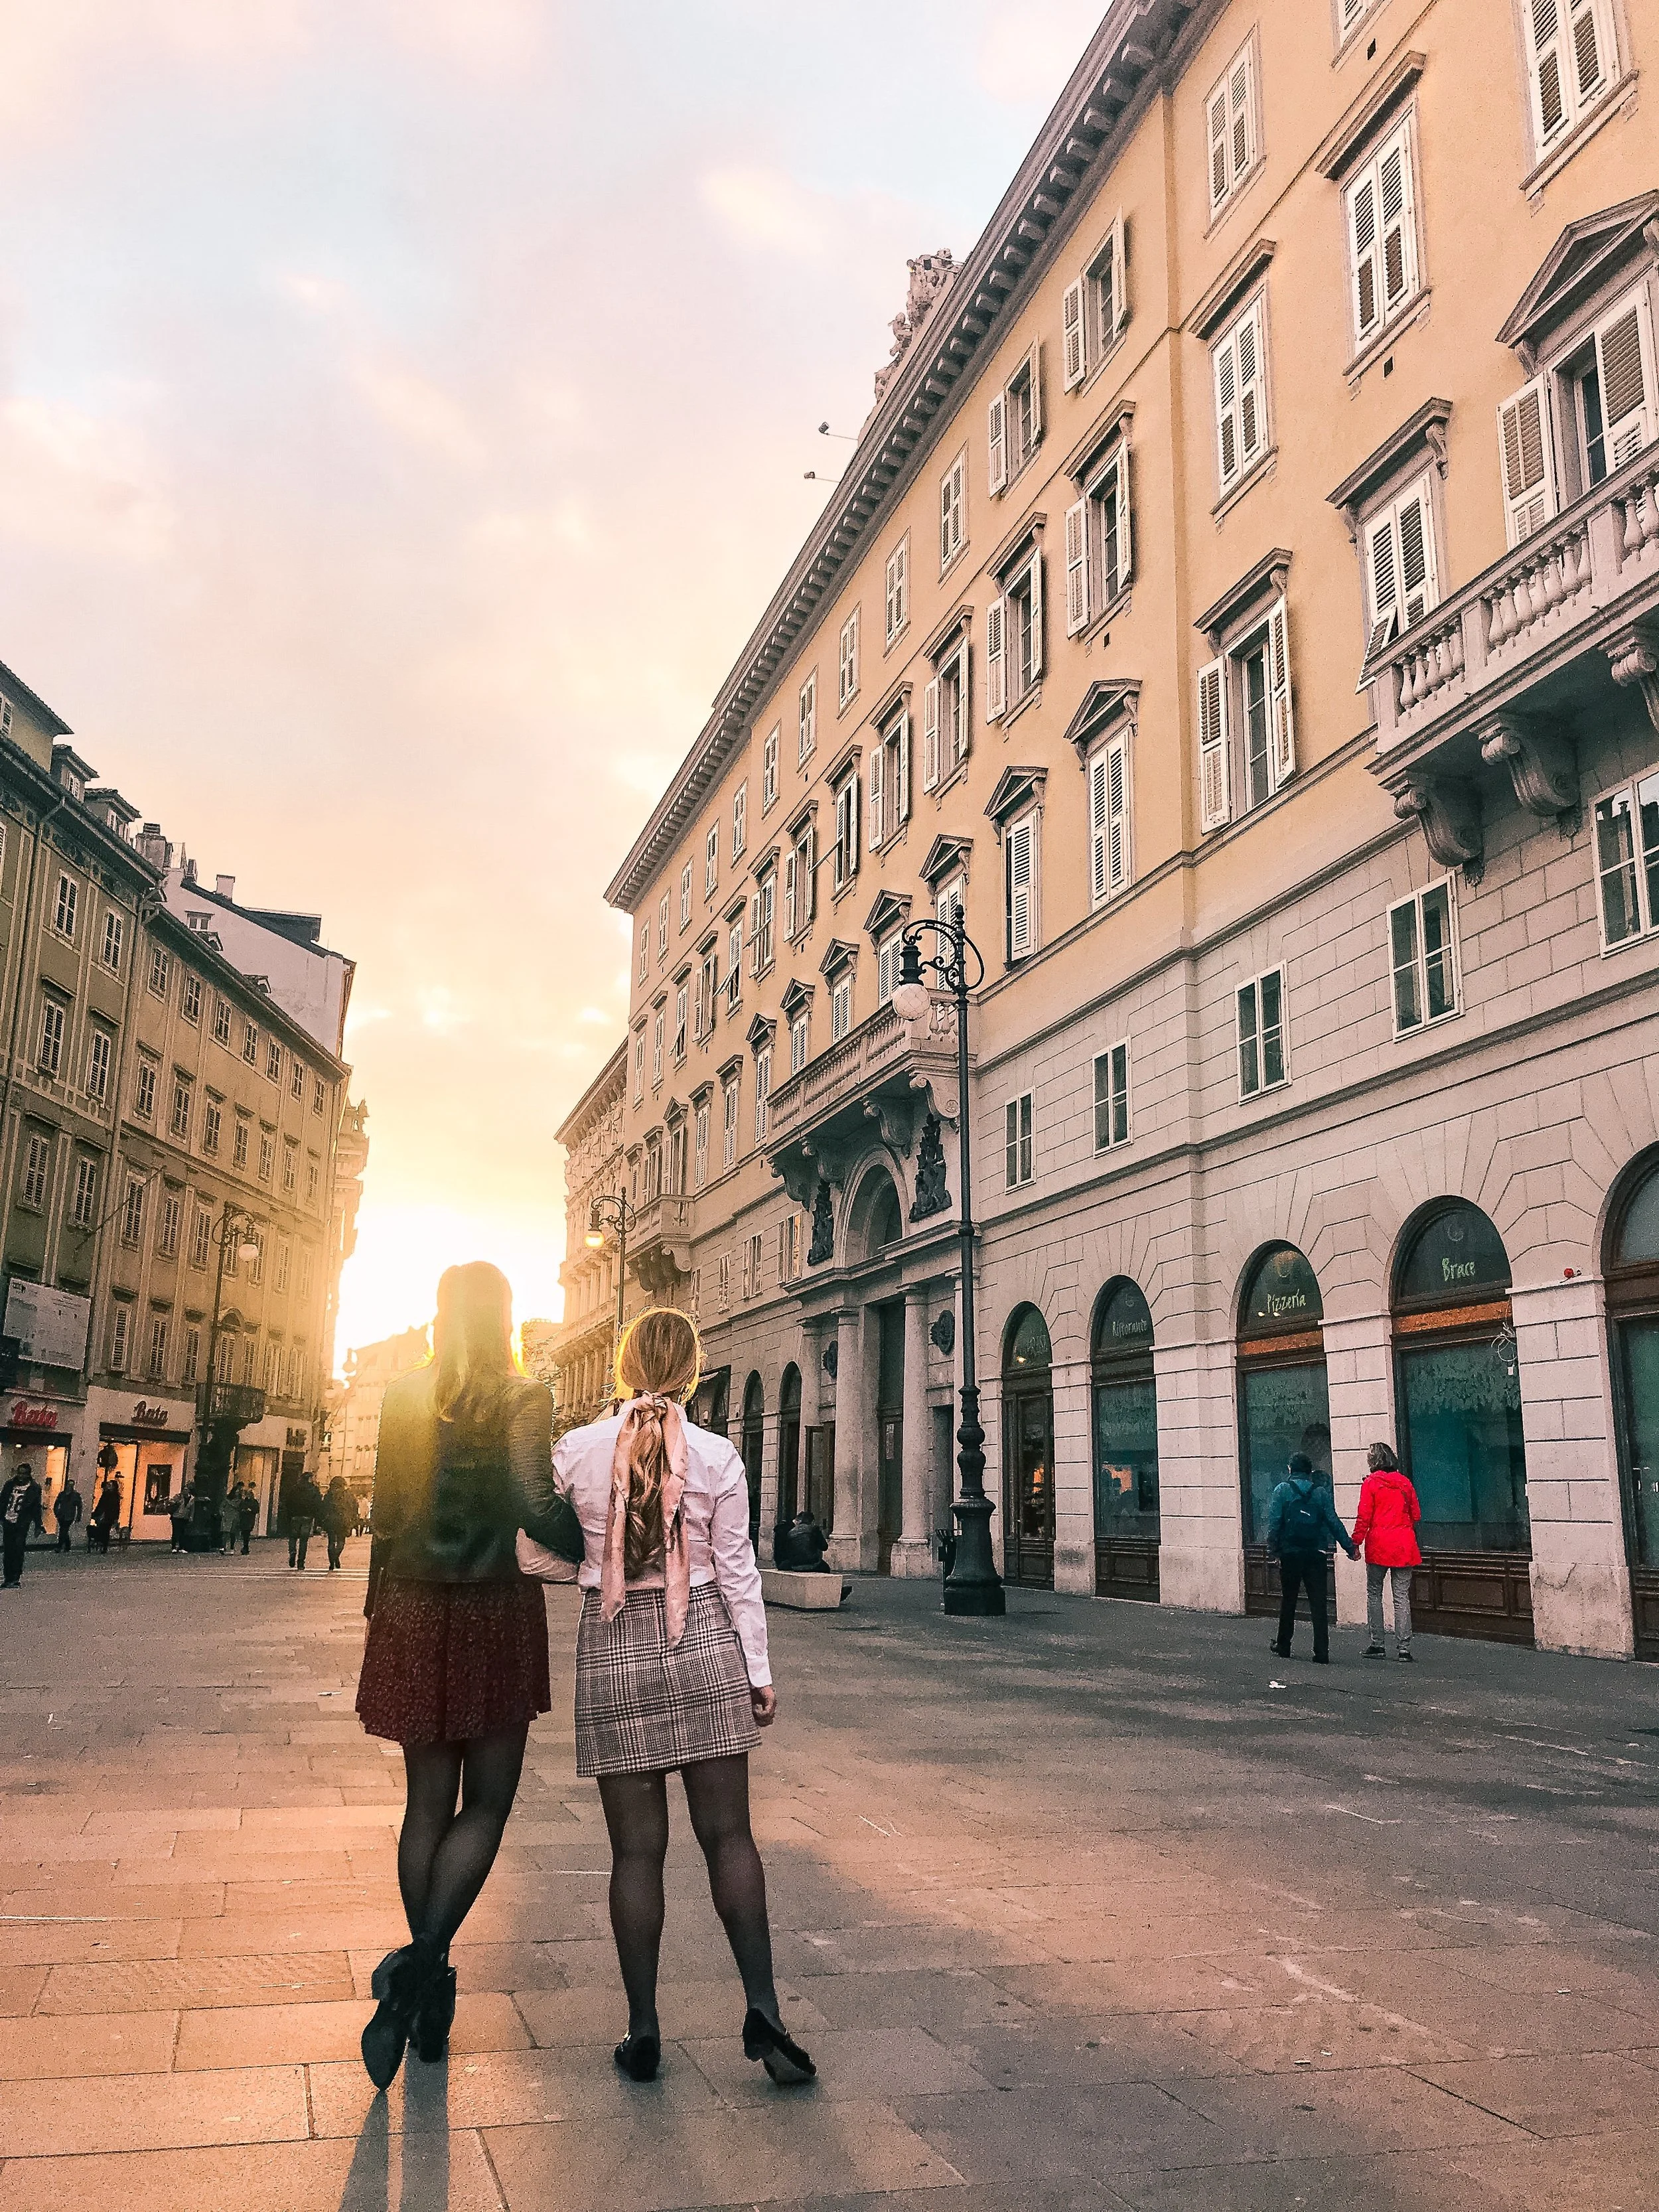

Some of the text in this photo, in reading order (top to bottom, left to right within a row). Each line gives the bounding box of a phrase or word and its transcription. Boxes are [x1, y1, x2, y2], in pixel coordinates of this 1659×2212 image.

[1442, 1258, 1476, 1282] Brace
[1267, 1288, 1306, 1313] Pizzeria
[131, 1400, 169, 1428] Bata
